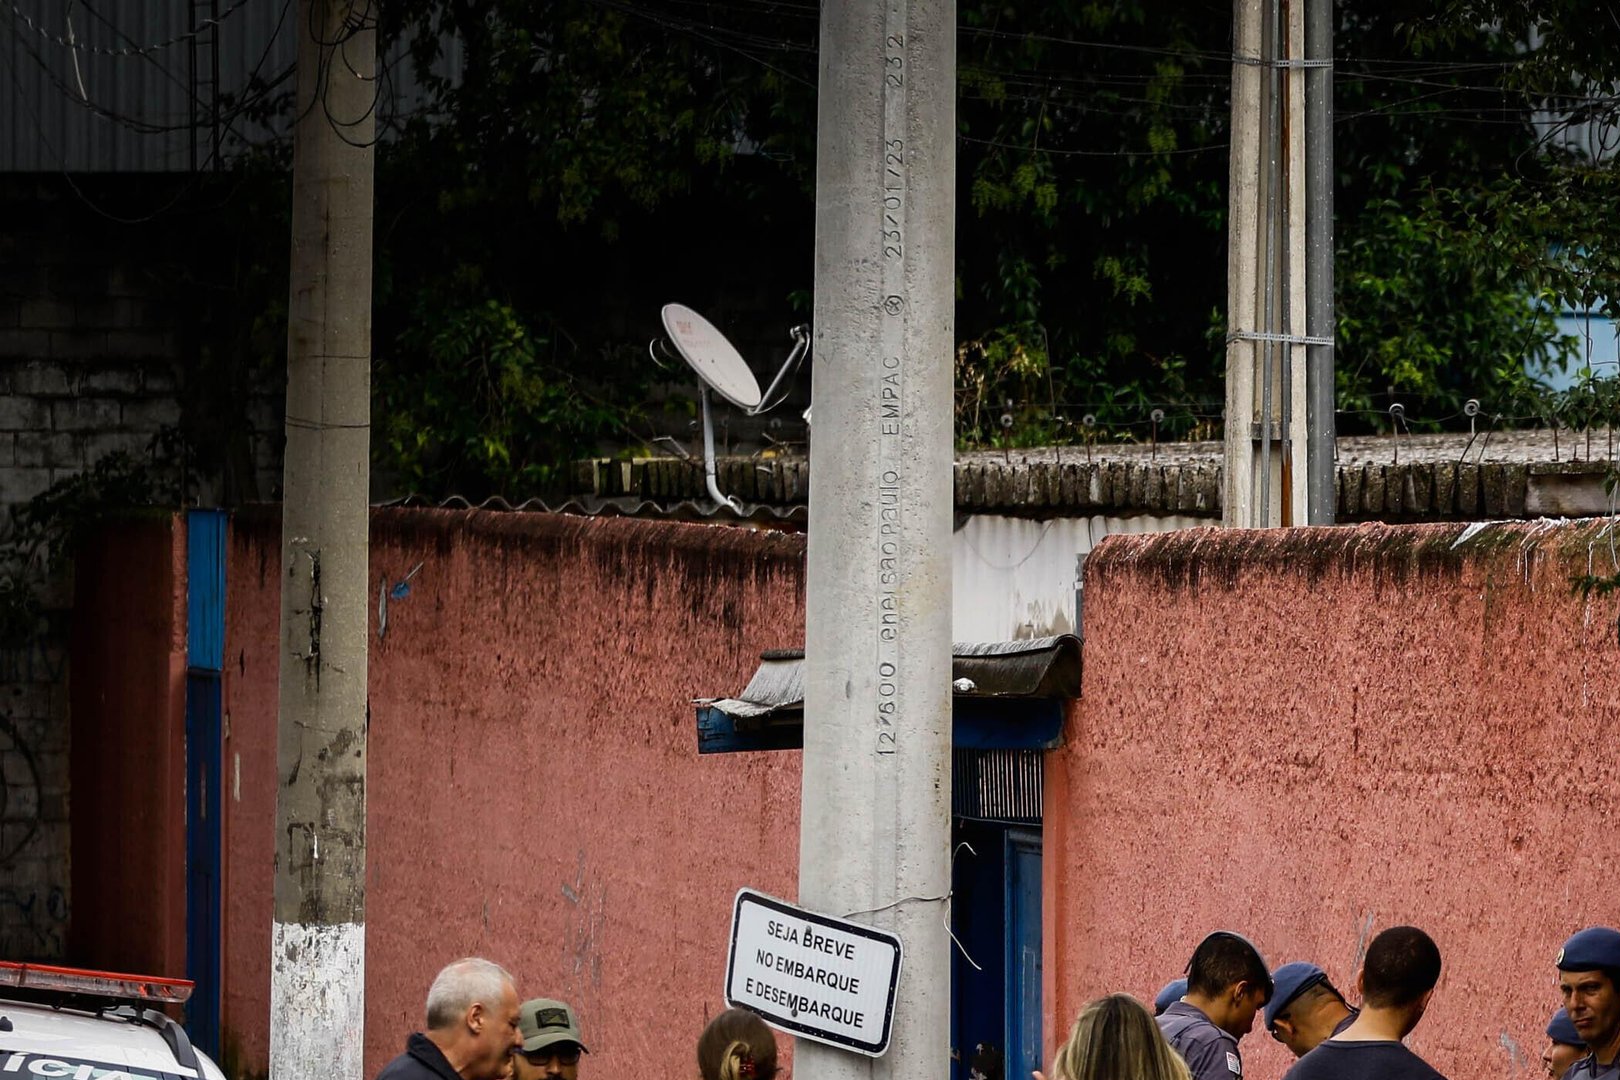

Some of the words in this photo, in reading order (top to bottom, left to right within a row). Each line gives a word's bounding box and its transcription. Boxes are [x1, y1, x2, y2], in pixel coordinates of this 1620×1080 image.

[882, 356, 900, 435] EMPAC
[767, 920, 799, 945] SEJA
[803, 932, 856, 960] BREVE
[756, 948, 774, 968] NO
[776, 956, 860, 995] EMBARQUE
[745, 977, 754, 994] E
[755, 981, 865, 1028] DESEMBARQUE
